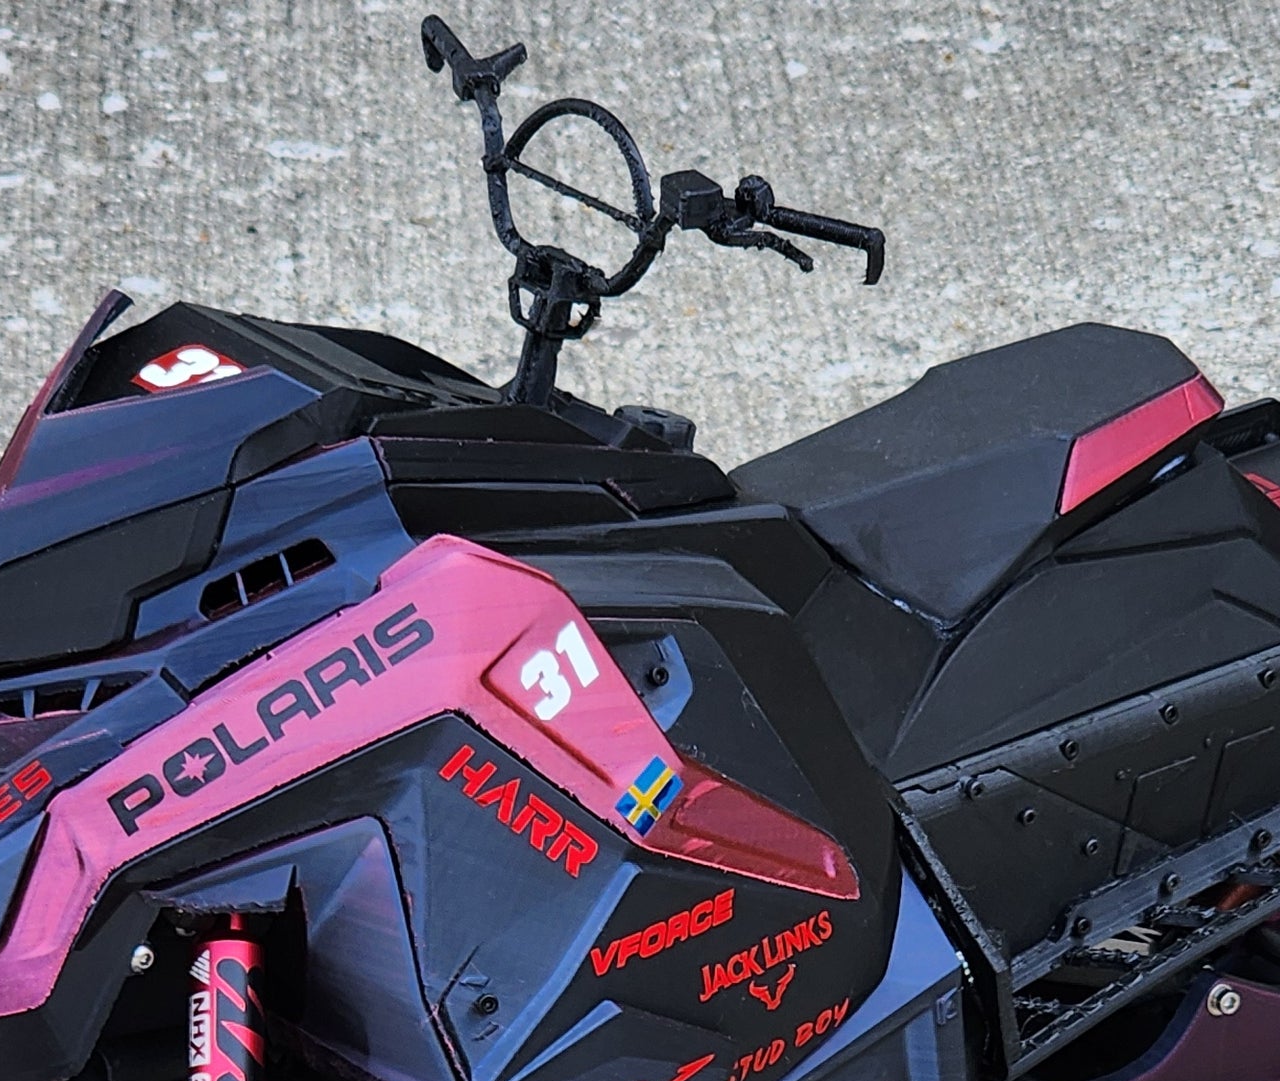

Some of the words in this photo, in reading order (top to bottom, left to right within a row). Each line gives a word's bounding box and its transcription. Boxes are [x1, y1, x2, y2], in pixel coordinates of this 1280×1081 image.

[520, 620, 600, 721] 31
[106, 602, 435, 837] POLARIS
[438, 744, 599, 878] HARR
[590, 888, 735, 977] VFORCE
[699, 944, 763, 1002] JACK
[761, 910, 834, 968] LINKS
[794, 997, 850, 1047] BOY
